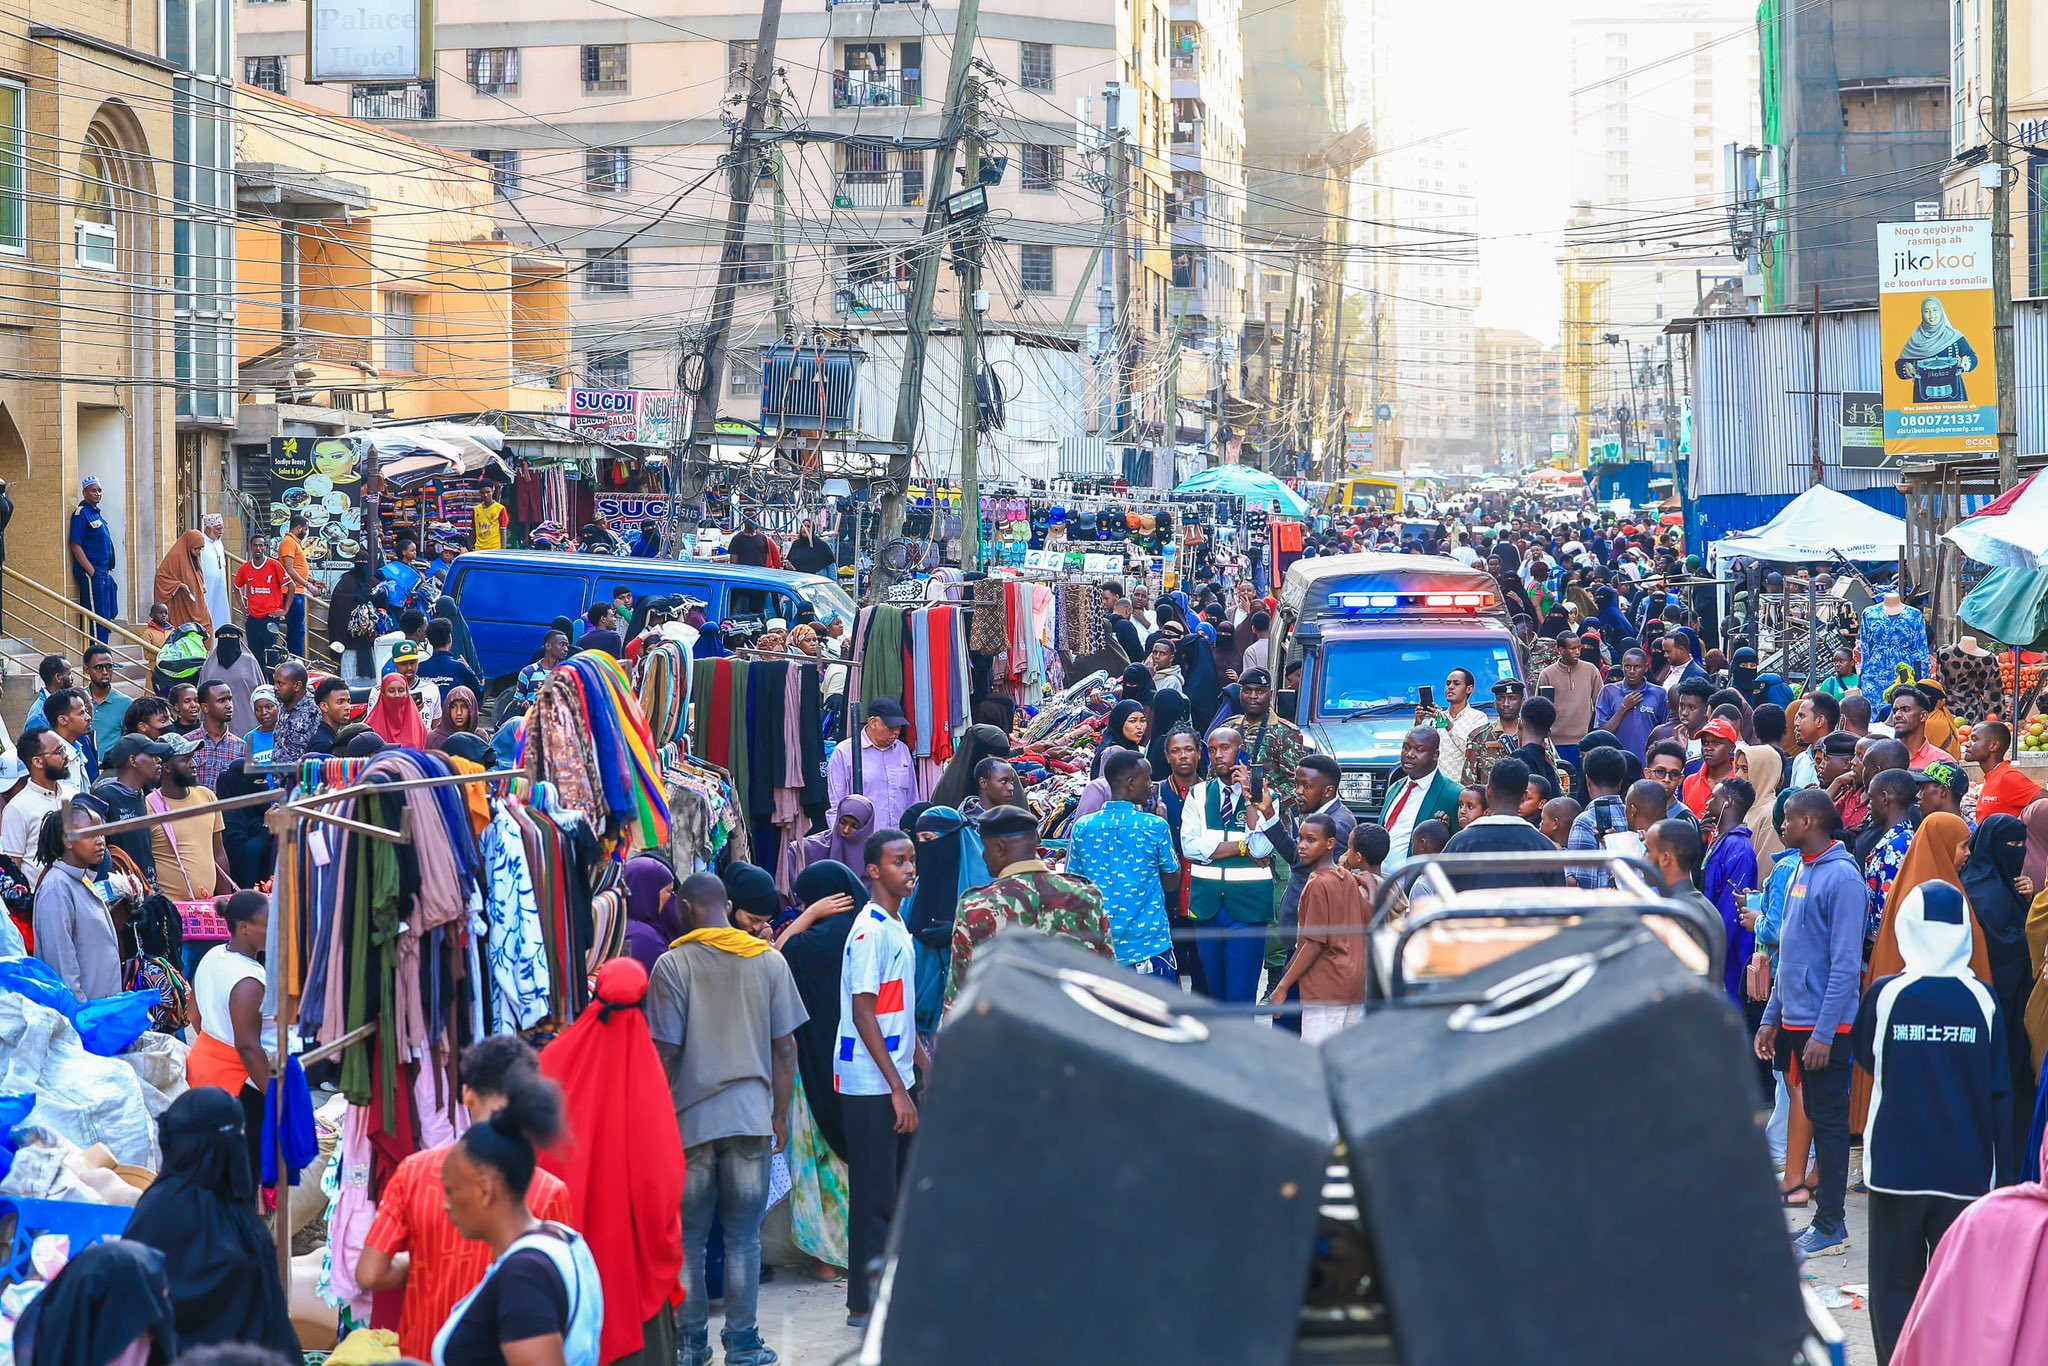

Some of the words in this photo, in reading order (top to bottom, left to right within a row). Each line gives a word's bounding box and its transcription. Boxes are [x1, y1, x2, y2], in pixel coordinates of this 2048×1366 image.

[318, 8, 414, 30] Palace
[330, 46, 406, 68] Hotel
[1894, 228, 1920, 236] Noqo
[1923, 225, 1974, 236] qeybiyaha
[1908, 238, 1946, 246] rasmiga
[1950, 236, 1962, 244] ah
[1894, 249, 1974, 278] jikokoa
[1898, 278, 1946, 288] koonfurta
[1950, 276, 1988, 286] somalia
[576, 392, 632, 410] SUCDI
[644, 396, 670, 420] SUCDI
[608, 415, 632, 426] SALON
[1900, 414, 1980, 426] 0800721337
[610, 520, 668, 534] BEAY
[1892, 1024, 1976, 1044] 瑞那士牙刷
